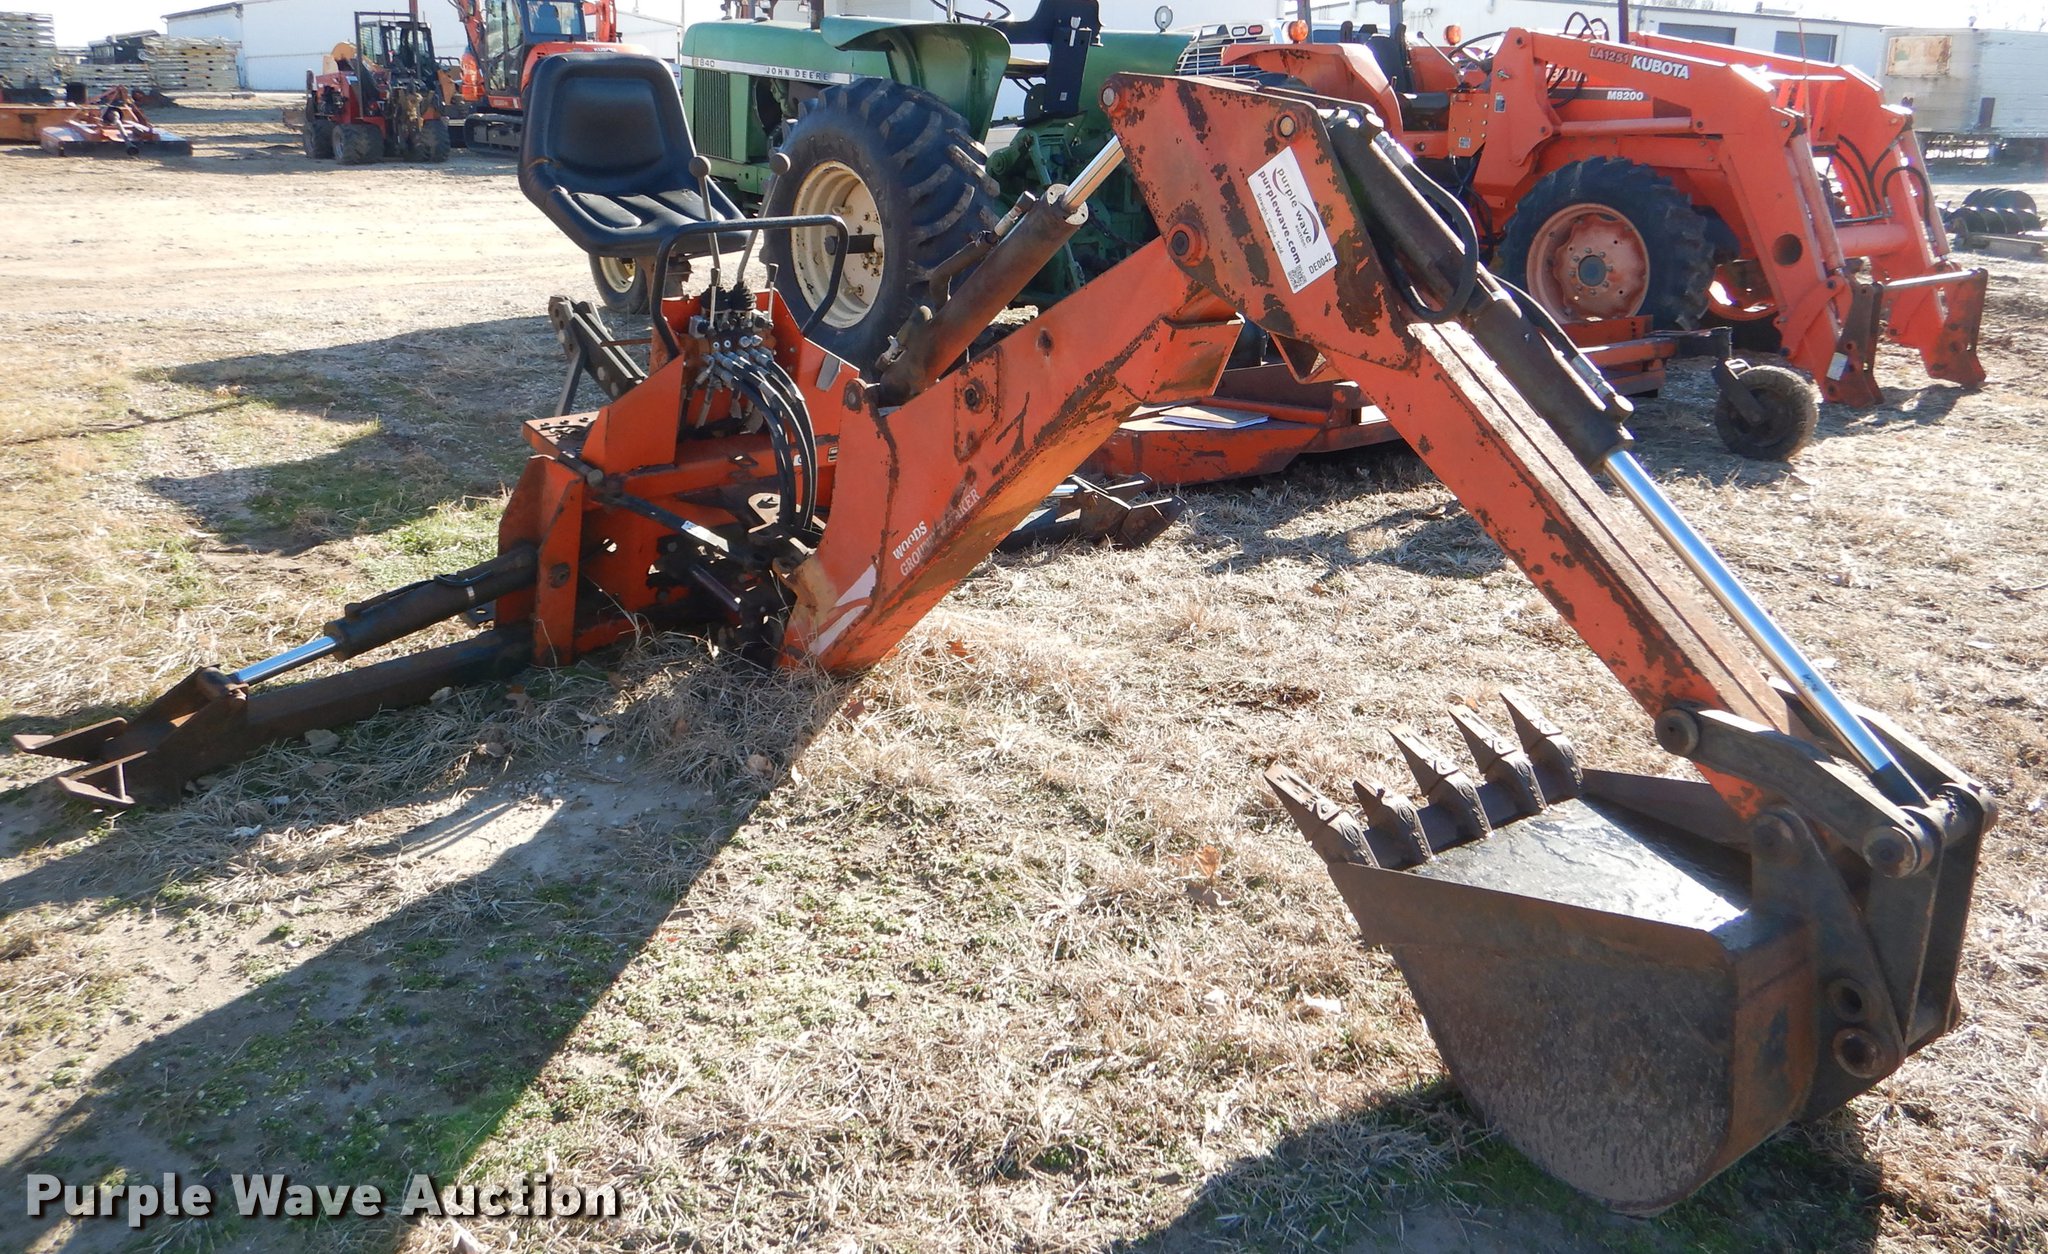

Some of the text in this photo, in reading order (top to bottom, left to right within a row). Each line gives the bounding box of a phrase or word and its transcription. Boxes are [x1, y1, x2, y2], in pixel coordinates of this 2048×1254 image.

[766, 66, 829, 81] JOHN DEERE
[1589, 47, 1690, 80] LA1251 KUBOTA
[1606, 90, 1644, 101] M8200
[1258, 170, 1301, 265] purplewave.com
[1276, 168, 1312, 244] purple wave
[1308, 252, 1333, 275] DE0042
[892, 520, 928, 560] WOODS
